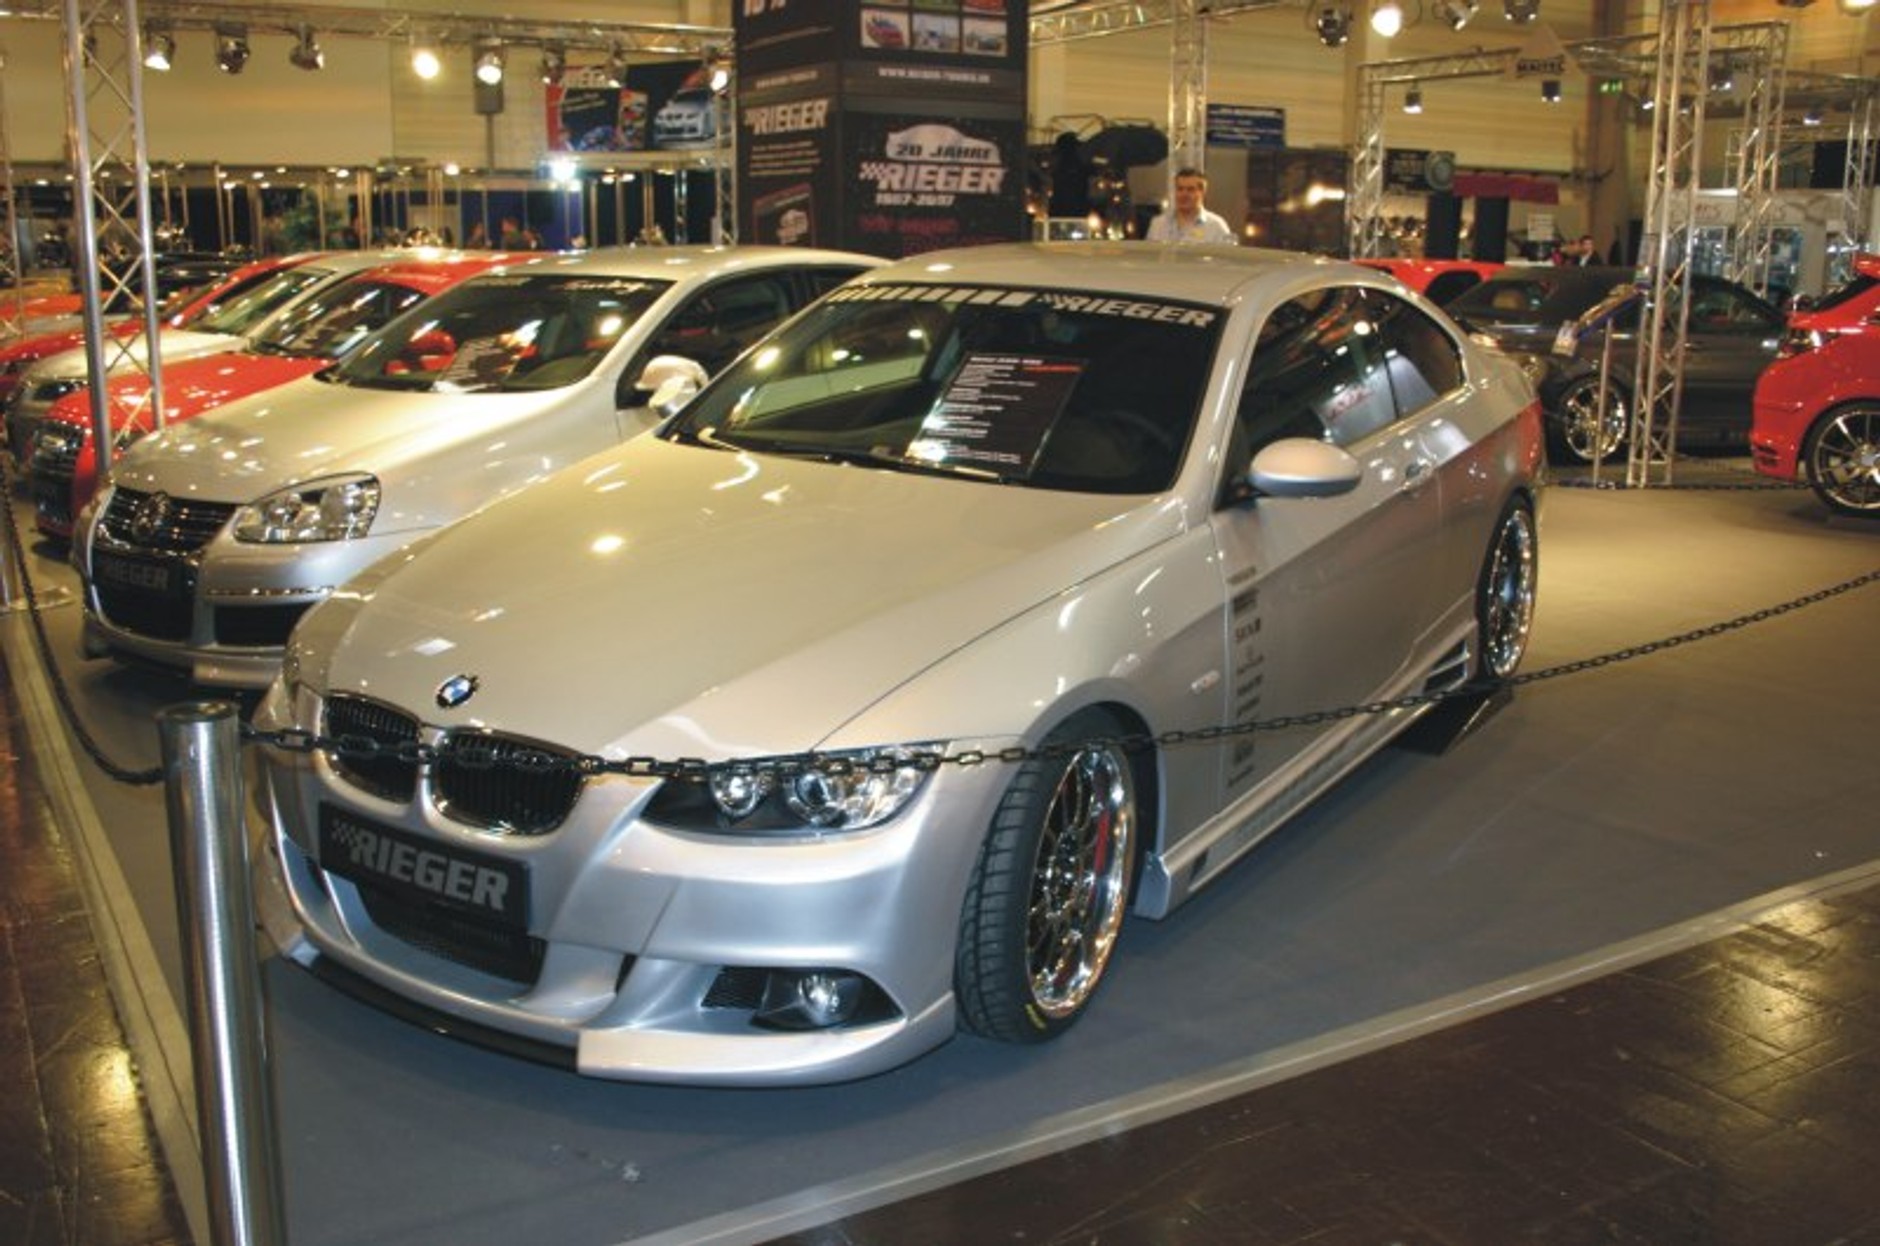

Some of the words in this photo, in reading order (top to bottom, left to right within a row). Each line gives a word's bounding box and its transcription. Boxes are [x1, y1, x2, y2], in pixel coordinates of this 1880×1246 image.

[752, 99, 829, 135] RIEGER
[896, 143, 922, 156] 20
[930, 144, 992, 159] JAHRE
[877, 162, 1006, 194] RIEGER
[1050, 297, 1215, 329] RIEGER
[351, 829, 510, 911] RIEGER
